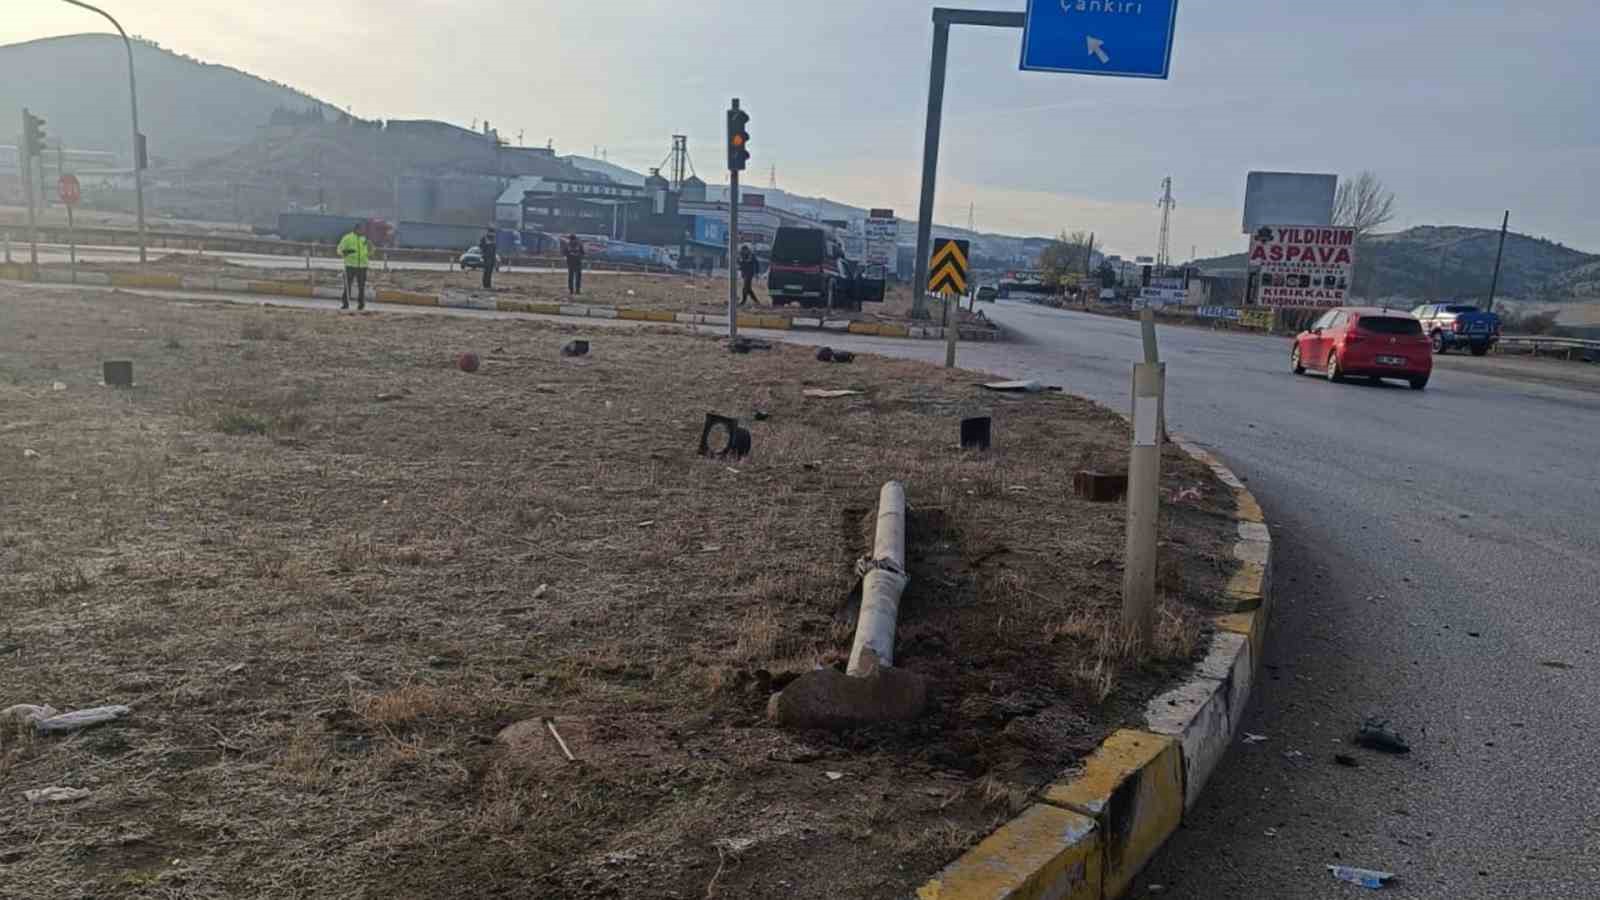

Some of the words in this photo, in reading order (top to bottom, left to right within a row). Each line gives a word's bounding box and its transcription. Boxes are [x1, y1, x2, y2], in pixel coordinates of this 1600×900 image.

[1278, 228, 1353, 245] YILDIRIM
[1251, 245, 1350, 264] ASPAVA
[1264, 288, 1343, 299] KIRIKKALE
